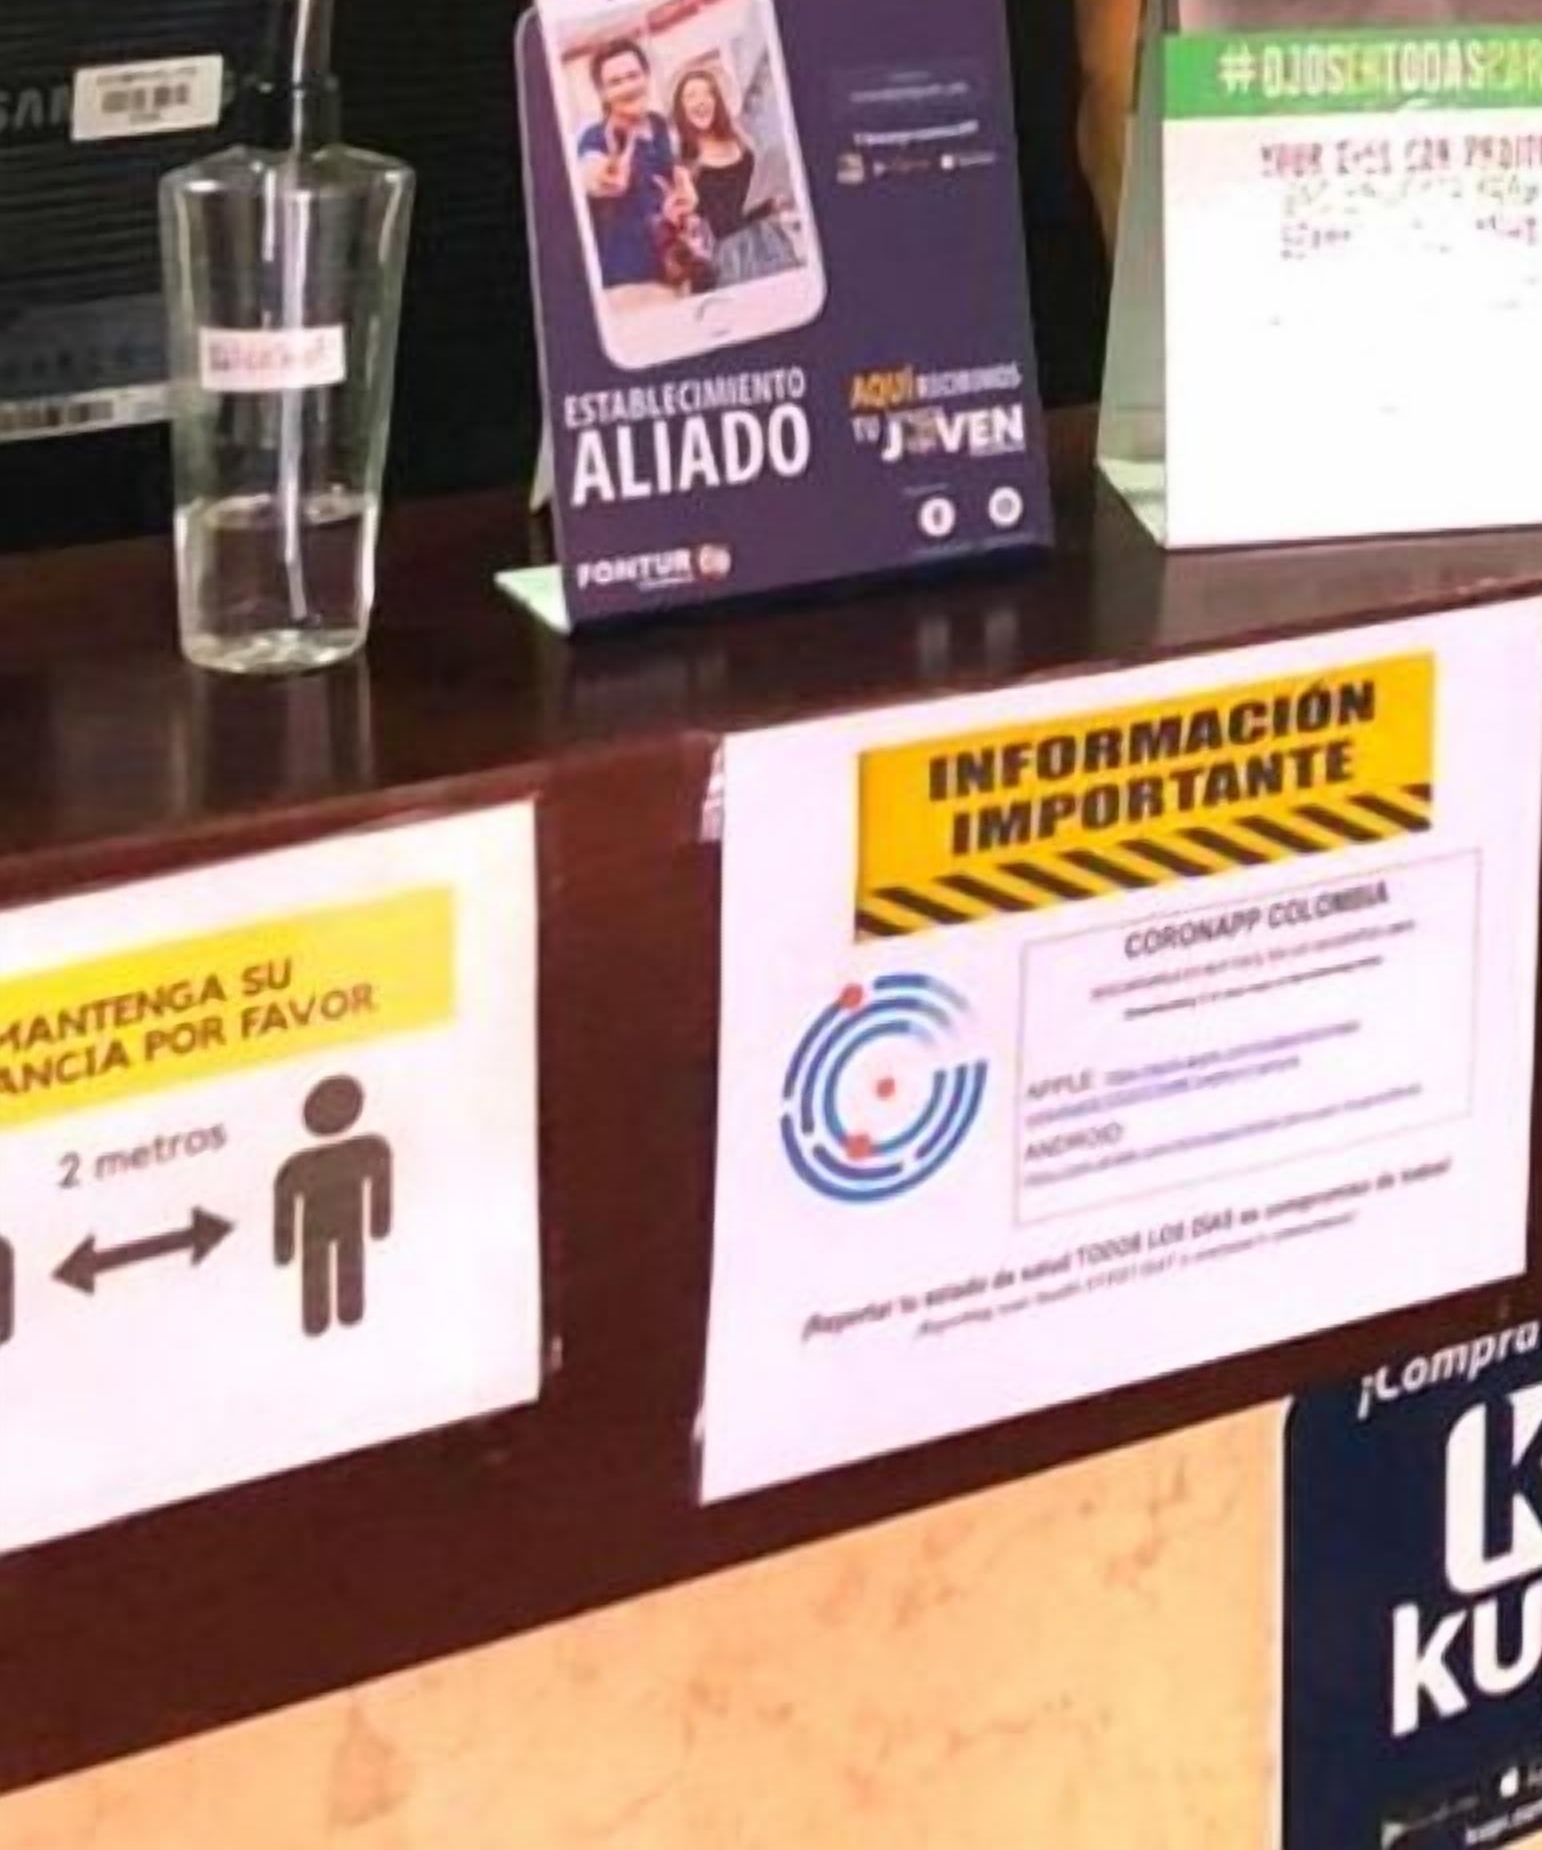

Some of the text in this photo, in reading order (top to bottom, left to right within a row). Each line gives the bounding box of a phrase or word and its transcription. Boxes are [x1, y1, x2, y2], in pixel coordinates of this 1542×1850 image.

[564, 366, 807, 430] ESTABLECIMIENTO
[571, 402, 811, 508] ALIADO
[929, 677, 1377, 803] INFORMACIÓN
[951, 739, 1356, 858] IMPORTANTE
[1124, 905, 1262, 960] CORONAPP
[240, 956, 294, 997] SU
[143, 1015, 227, 1062] POR
[240, 982, 376, 1040] FAVOR
[57, 1122, 229, 1191] 2 metros
